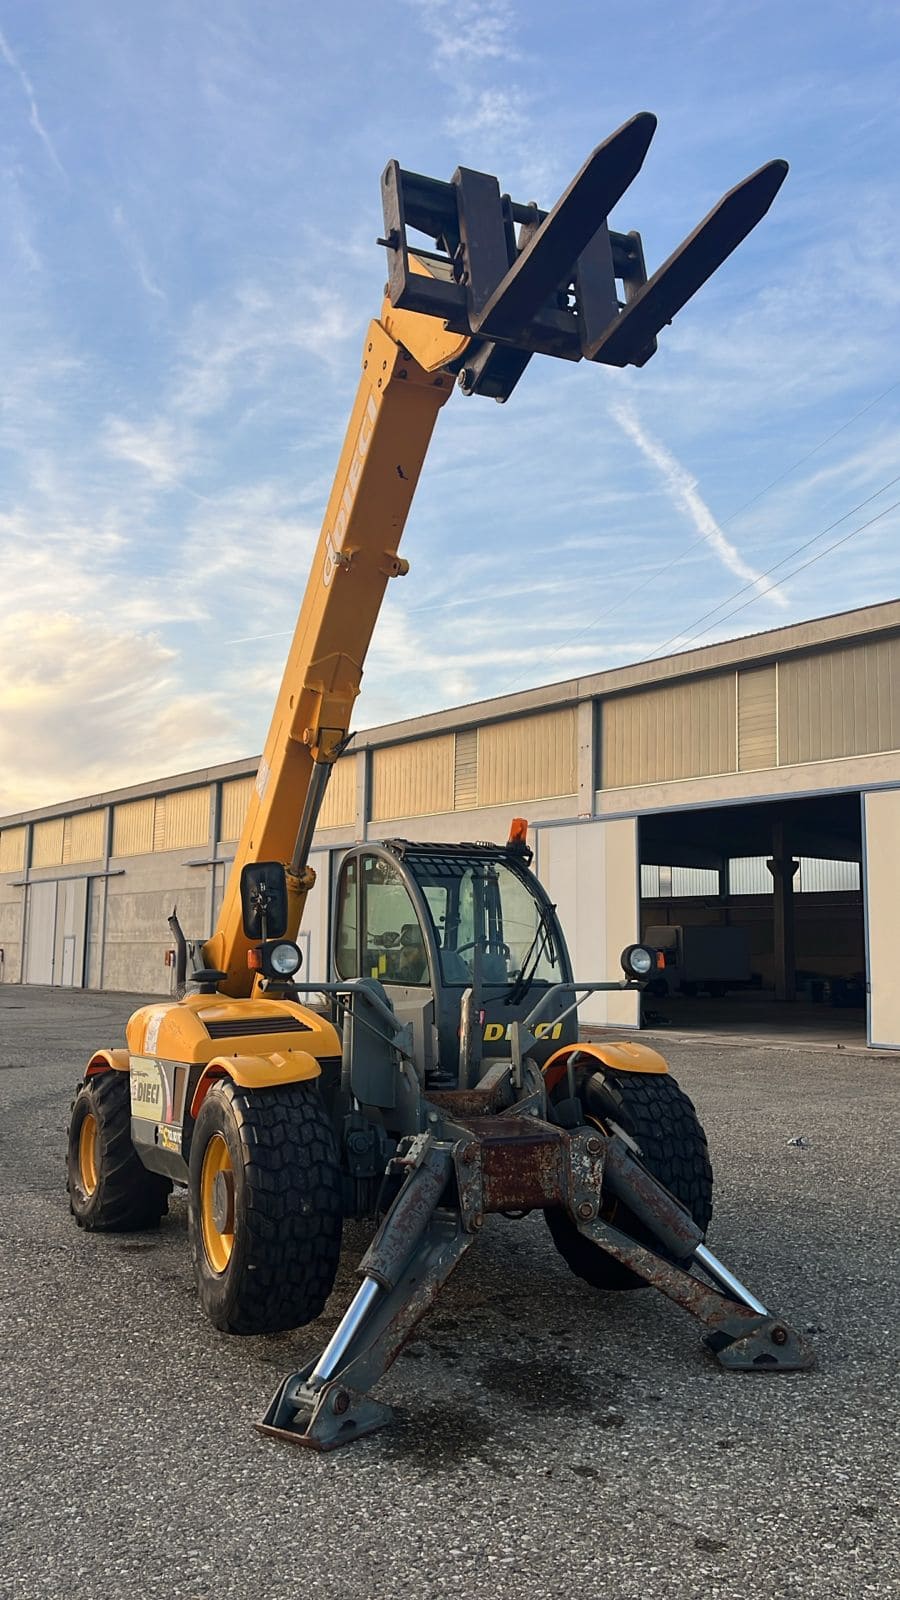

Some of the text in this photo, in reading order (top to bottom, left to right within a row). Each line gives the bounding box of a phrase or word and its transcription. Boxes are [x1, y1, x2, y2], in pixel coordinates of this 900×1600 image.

[333, 394, 378, 550] DIECI
[483, 1023, 563, 1041] DICI
[137, 1082, 160, 1104] DIECI
